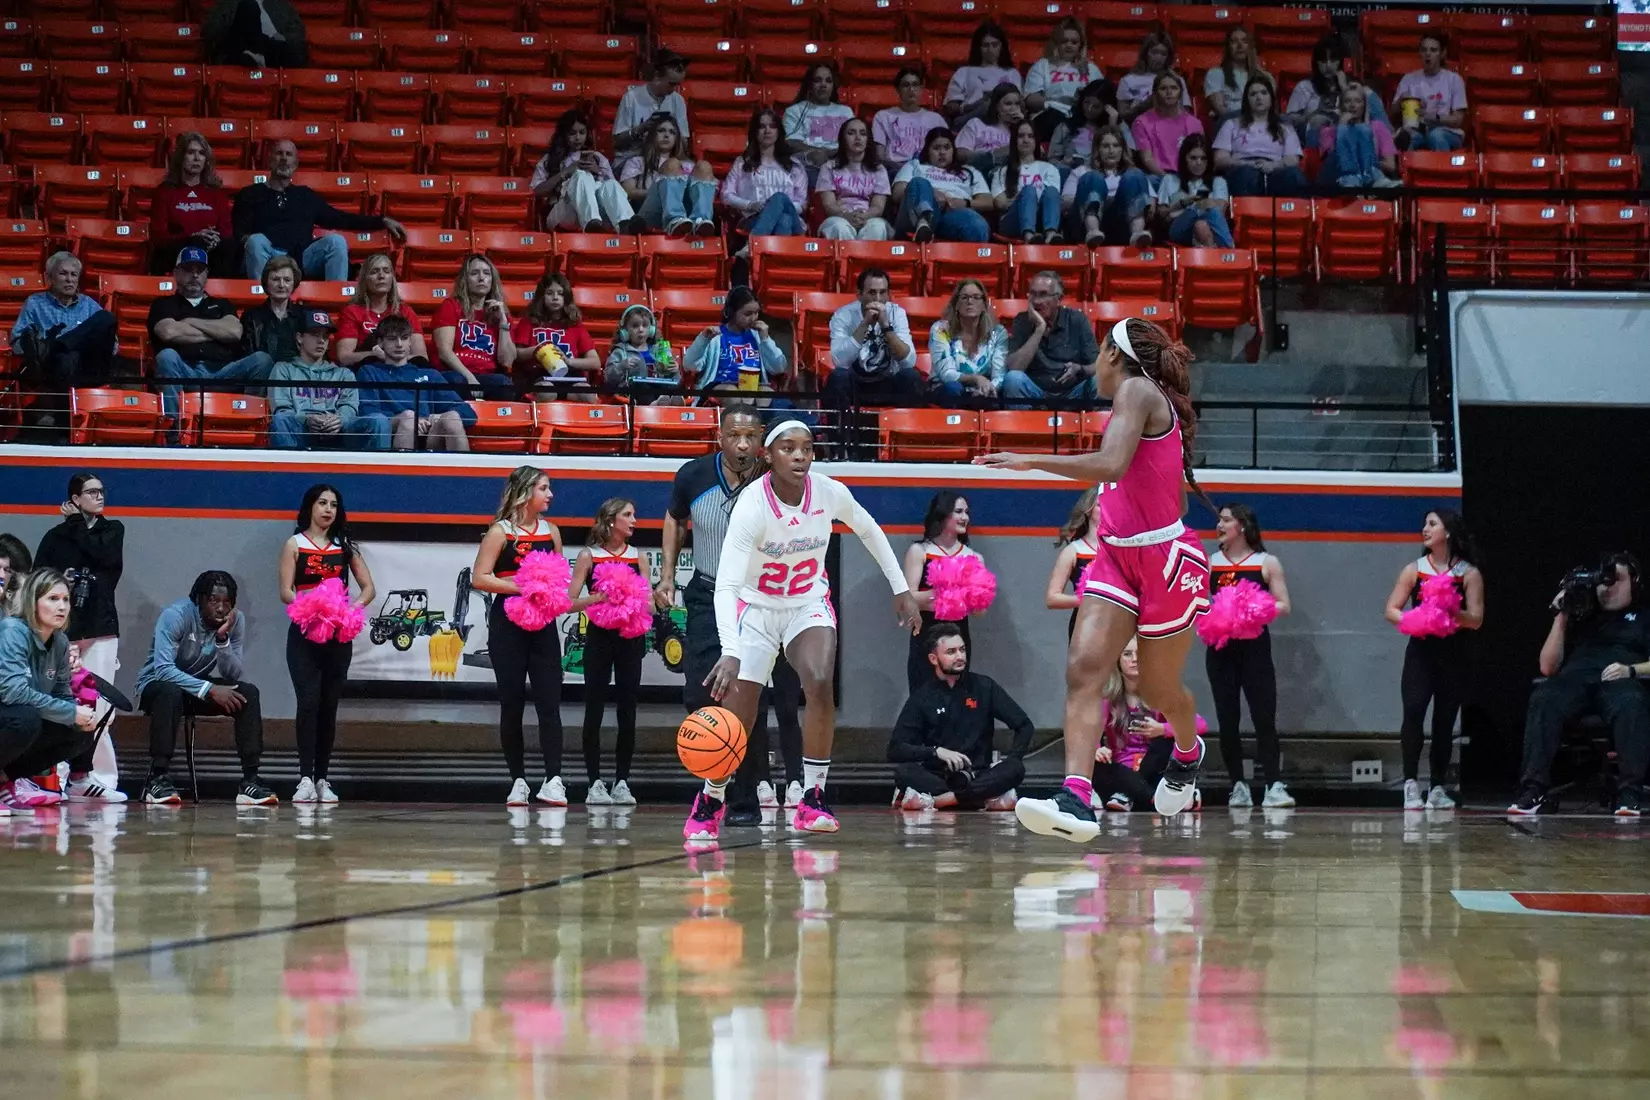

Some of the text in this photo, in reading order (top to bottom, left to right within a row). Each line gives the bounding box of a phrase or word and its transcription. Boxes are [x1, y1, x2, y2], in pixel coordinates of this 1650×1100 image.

[1619, 24, 1644, 32] BEYOND
[1050, 71, 1089, 84] ZTA
[1020, 174, 1043, 186] TA
[757, 540, 784, 559] Lady
[656, 552, 692, 566] RCH
[758, 558, 818, 596] 22
[679, 726, 698, 740] EVO
